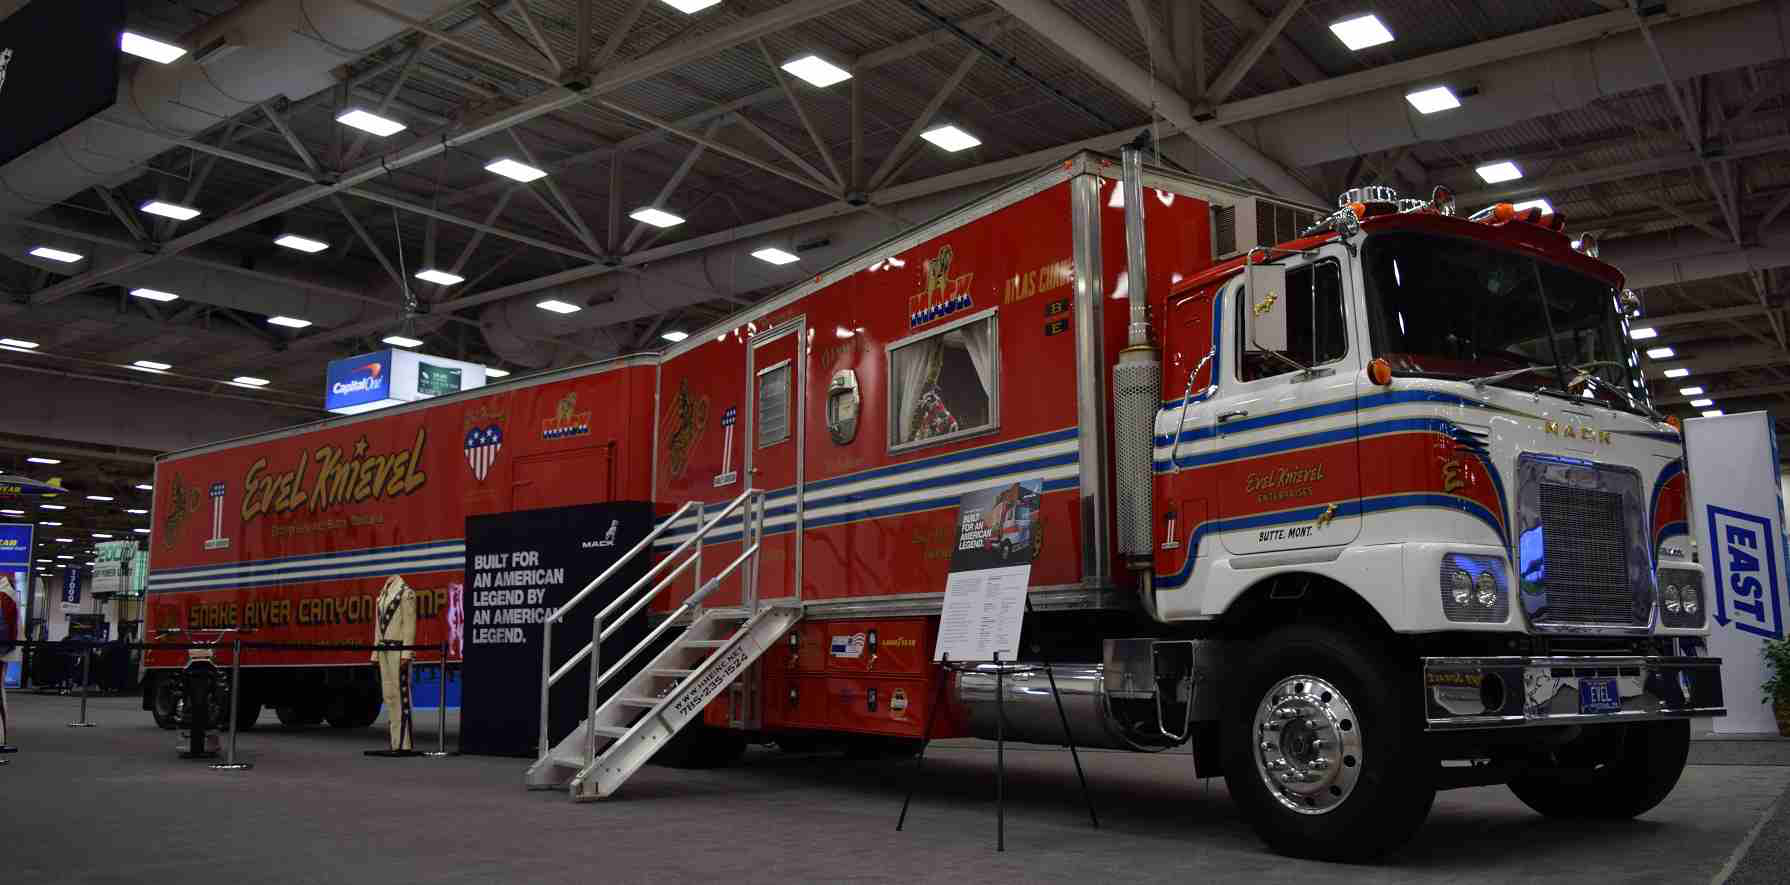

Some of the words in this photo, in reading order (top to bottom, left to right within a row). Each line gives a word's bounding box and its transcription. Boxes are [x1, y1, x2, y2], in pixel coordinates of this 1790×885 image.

[1544, 420, 1613, 445] MACK
[960, 528, 993, 541] AMERICAN
[474, 554, 509, 570] BUILT
[512, 551, 539, 567] FOR
[473, 573, 491, 588] AN
[494, 568, 564, 587] AMERICAN
[473, 590, 524, 606] LEGEND
[527, 588, 546, 604] BY
[189, 603, 240, 627] SNAKE
[244, 597, 292, 624] RIVER
[298, 593, 375, 624] CANYON
[473, 610, 490, 625] AN
[472, 628, 527, 644] LEGEND.
